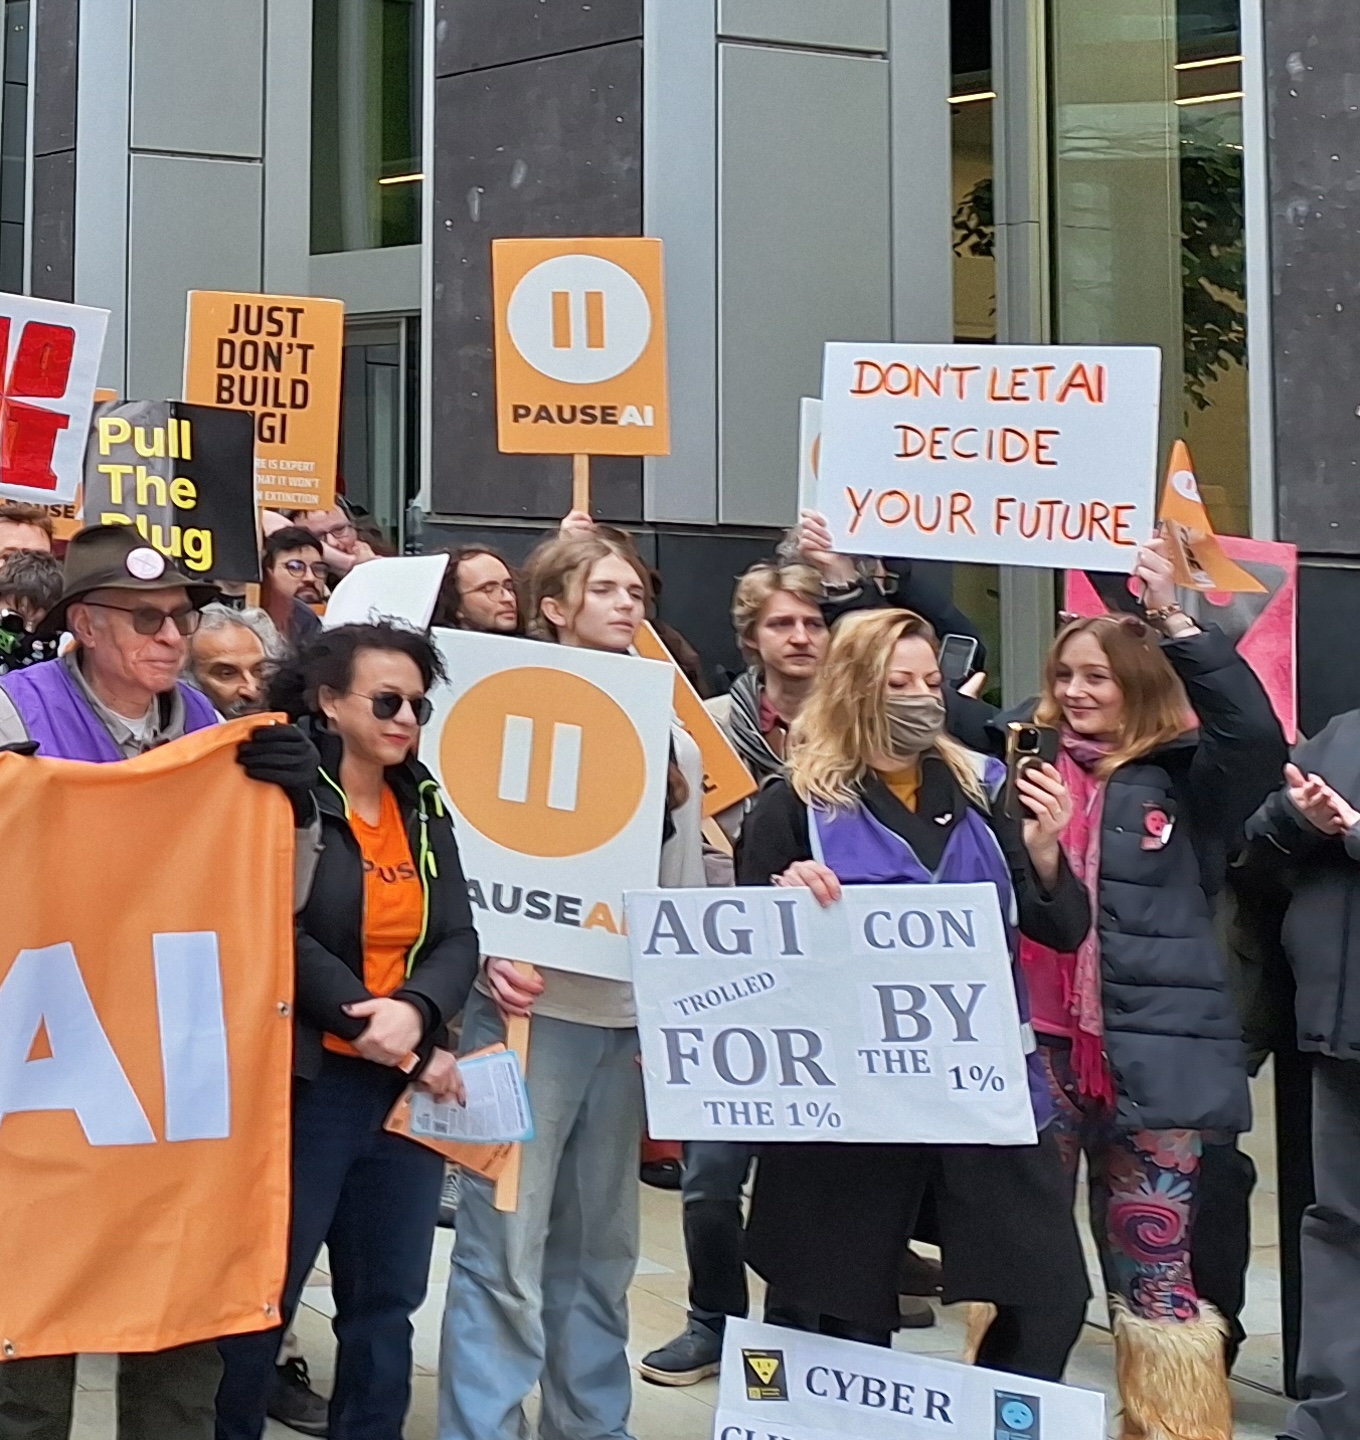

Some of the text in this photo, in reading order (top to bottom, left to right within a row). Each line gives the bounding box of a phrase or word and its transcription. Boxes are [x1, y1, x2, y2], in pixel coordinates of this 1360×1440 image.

[228, 303, 305, 338] JUST
[216, 338, 315, 375] DON'T
[215, 373, 309, 410] BUILD
[849, 360, 1105, 404] DON'T LET AI
[257, 412, 287, 445] GI
[511, 404, 655, 427] PAUSEAI
[97, 417, 192, 461] Pull
[893, 424, 1061, 466] DECIDE
[97, 464, 198, 510] The
[845, 485, 1138, 546] YOUR FUTURE
[100, 512, 213, 572] lug
[467, 878, 628, 936] AUSEA
[863, 910, 977, 950] CON
[673, 971, 777, 1018] TROLLED
[872, 983, 988, 1044] BY
[659, 1027, 837, 1088] FOR
[858, 1049, 1005, 1093] THE 1%
[703, 1101, 842, 1129] THE 1%
[805, 1365, 956, 1426] CYBER
